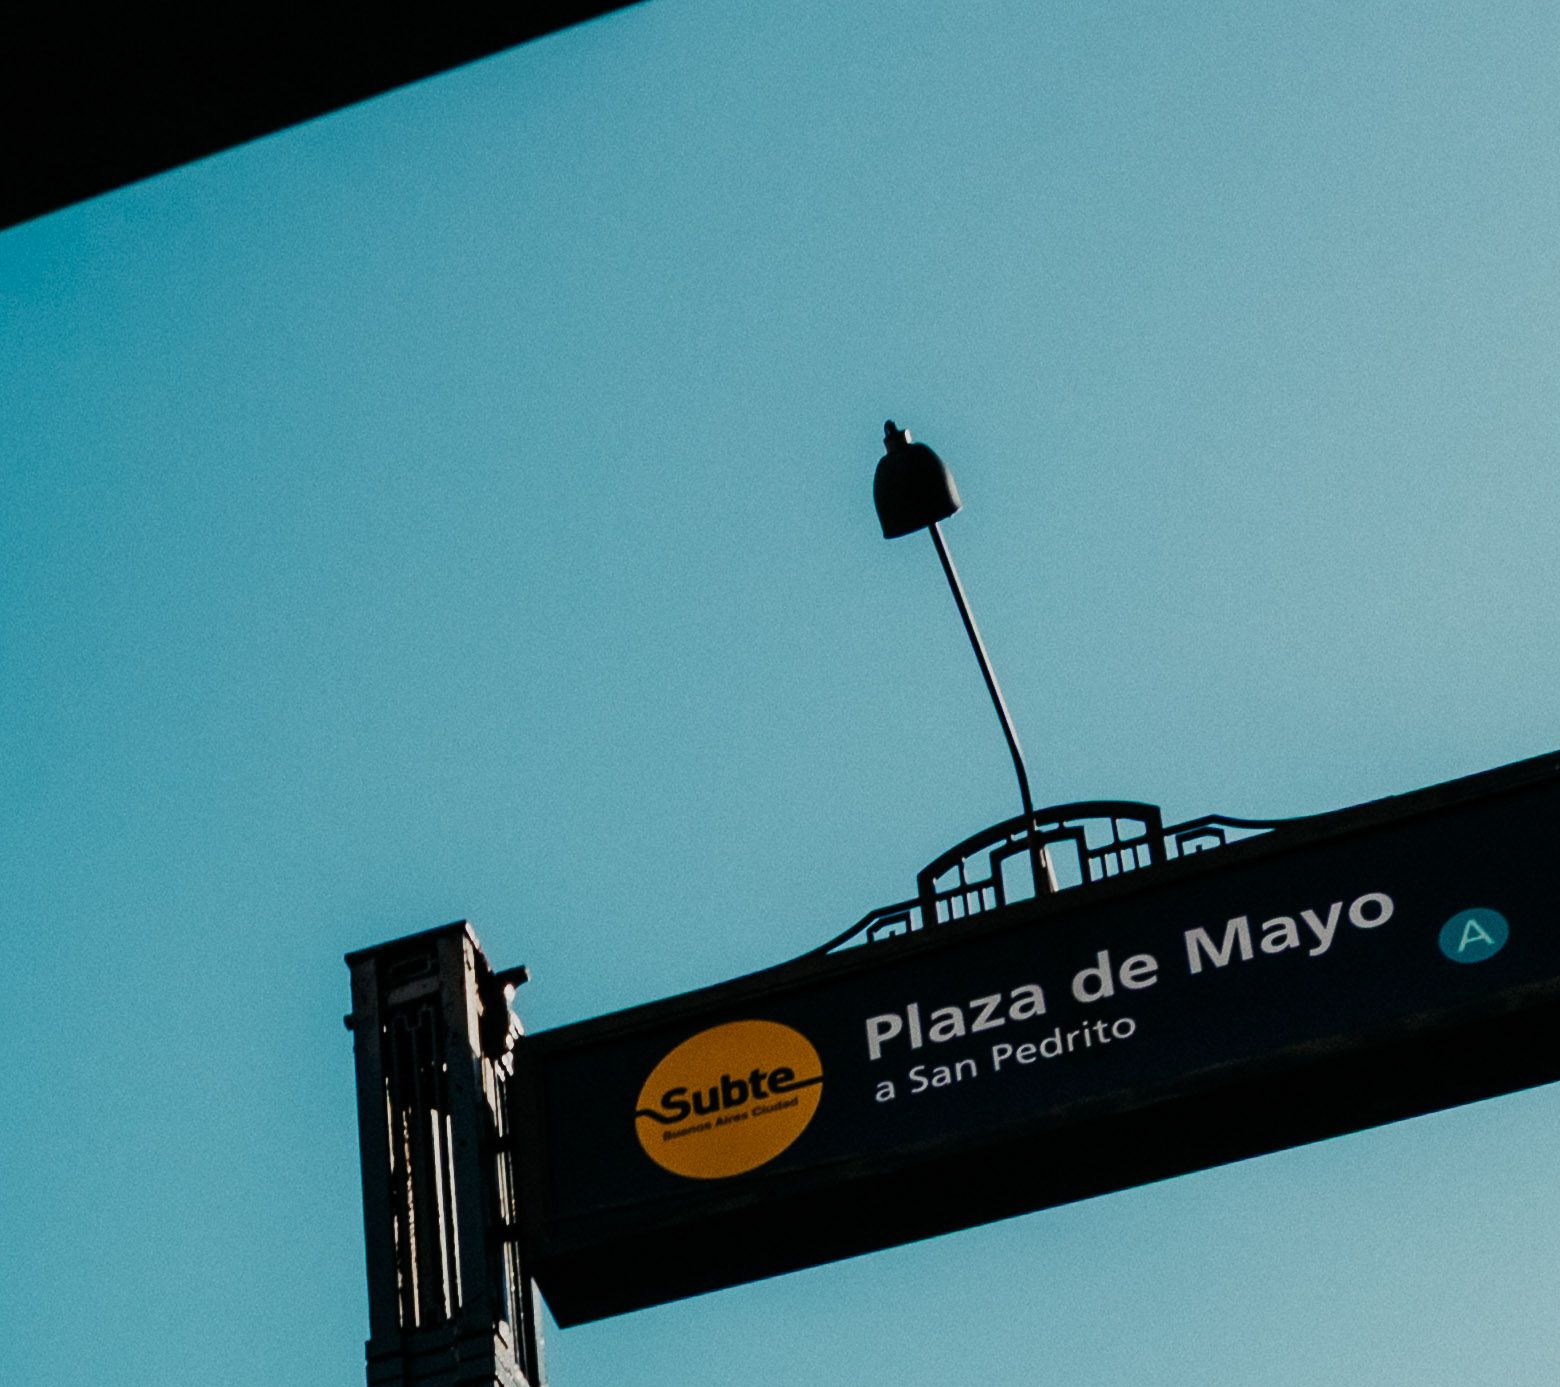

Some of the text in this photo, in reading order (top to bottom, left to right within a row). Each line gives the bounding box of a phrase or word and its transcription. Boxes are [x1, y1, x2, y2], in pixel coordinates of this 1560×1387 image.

[1457, 918, 1494, 953] A
[865, 891, 1395, 1060] Plaza de Mayo
[874, 1017, 1137, 1102] a San Pedrito
[658, 1066, 800, 1124] Subte
[663, 1096, 799, 1142] Buenos Aires Ciudad
